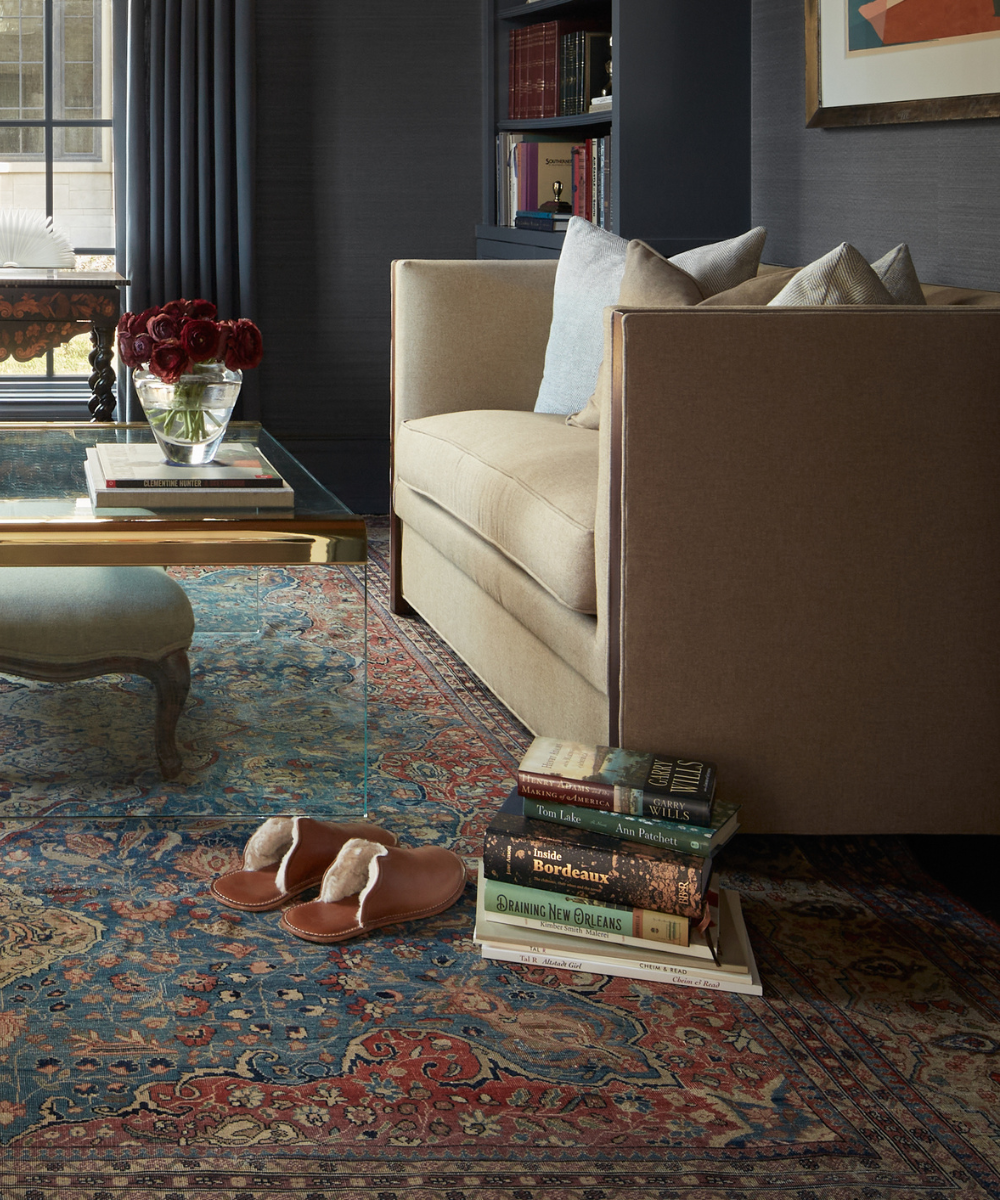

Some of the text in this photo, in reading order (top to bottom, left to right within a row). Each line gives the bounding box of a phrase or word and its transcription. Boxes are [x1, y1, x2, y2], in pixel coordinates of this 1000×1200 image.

[143, 479, 179, 488] CLEMENTINE
[179, 479, 202, 487] HUNTER
[647, 758, 674, 788] GARRY
[669, 758, 704, 794] WILLS
[521, 774, 555, 787] HENRY
[557, 779, 590, 794] ADAMS
[521, 785, 558, 799] MAKING
[567, 793, 611, 808] AMERICA
[653, 797, 687, 811] GARRY
[649, 805, 690, 822] WILLS
[536, 804, 558, 819] Tom
[559, 807, 582, 826] Lake
[615, 822, 636, 838] Ann
[638, 827, 679, 847] Patchett
[533, 847, 563, 862] Inside
[532, 858, 611, 886] Bordeaux
[496, 893, 623, 932] DRAINING NEW ORLEANS
[540, 920, 564, 932] Kimber
[564, 923, 584, 935] Smith
[519, 954, 531, 963] Tal
[531, 956, 539, 964] R
[541, 957, 568, 970] Altstadt
[568, 961, 583, 971] Girl
[672, 975, 693, 985] Cheim
[702, 978, 722, 989] Read
[639, 962, 661, 972] CHEIM
[669, 966, 688, 976] READ
